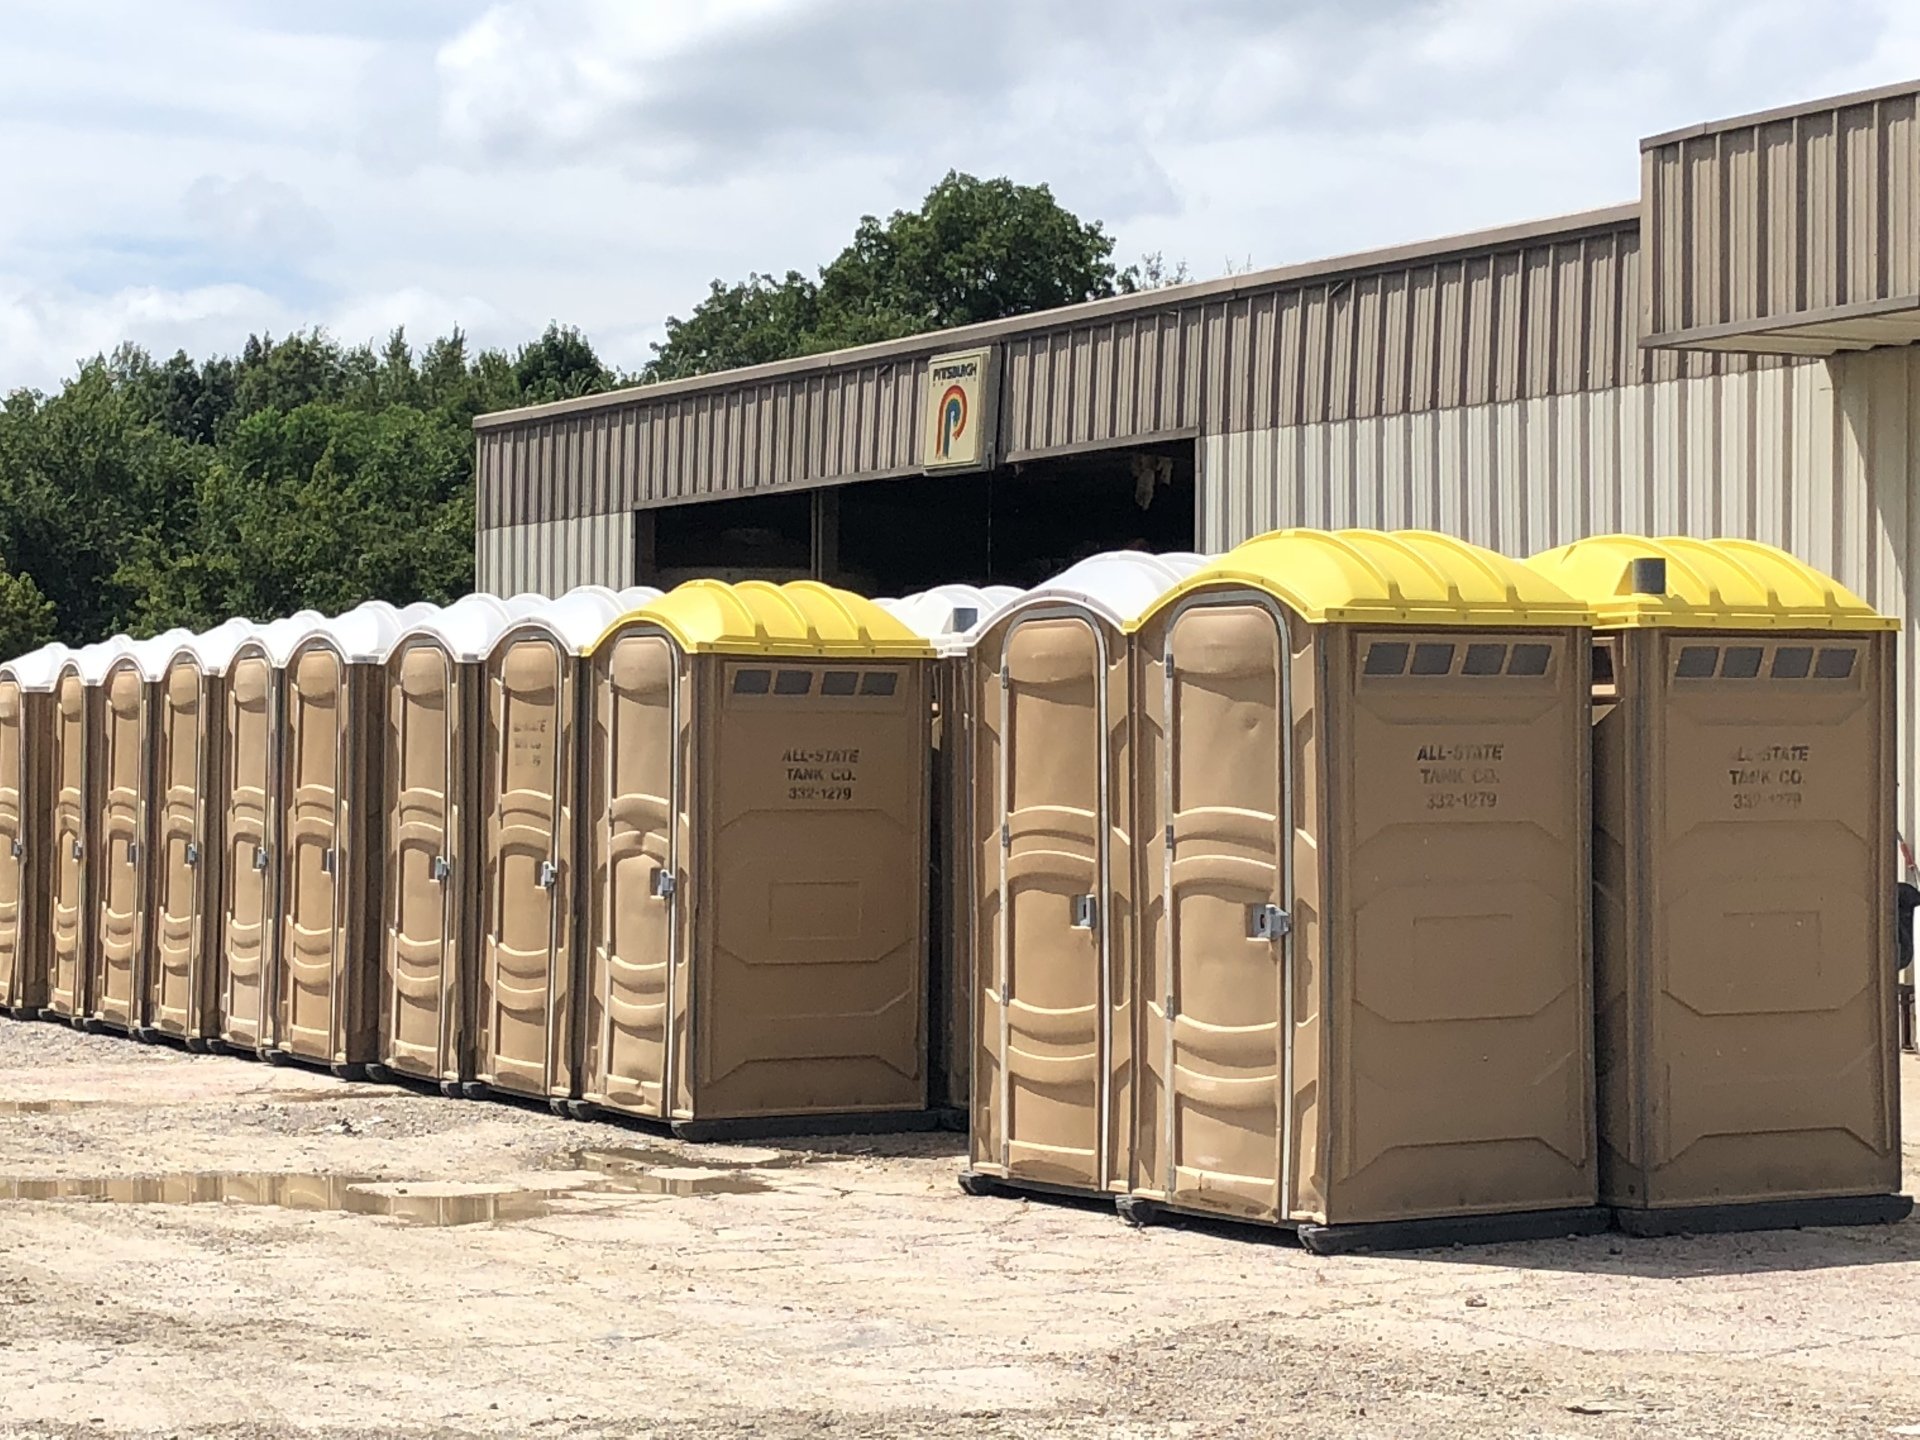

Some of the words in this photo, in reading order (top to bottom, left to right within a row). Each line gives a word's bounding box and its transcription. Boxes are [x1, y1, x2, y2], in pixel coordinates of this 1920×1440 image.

[782, 748, 860, 763] ALL-STATE
[1417, 744, 1504, 761] ALL-STATE
[787, 767, 824, 781] TANK
[831, 768, 857, 781] CO.
[788, 787, 852, 800] 332-1279
[1426, 791, 1497, 809] 332-1279
